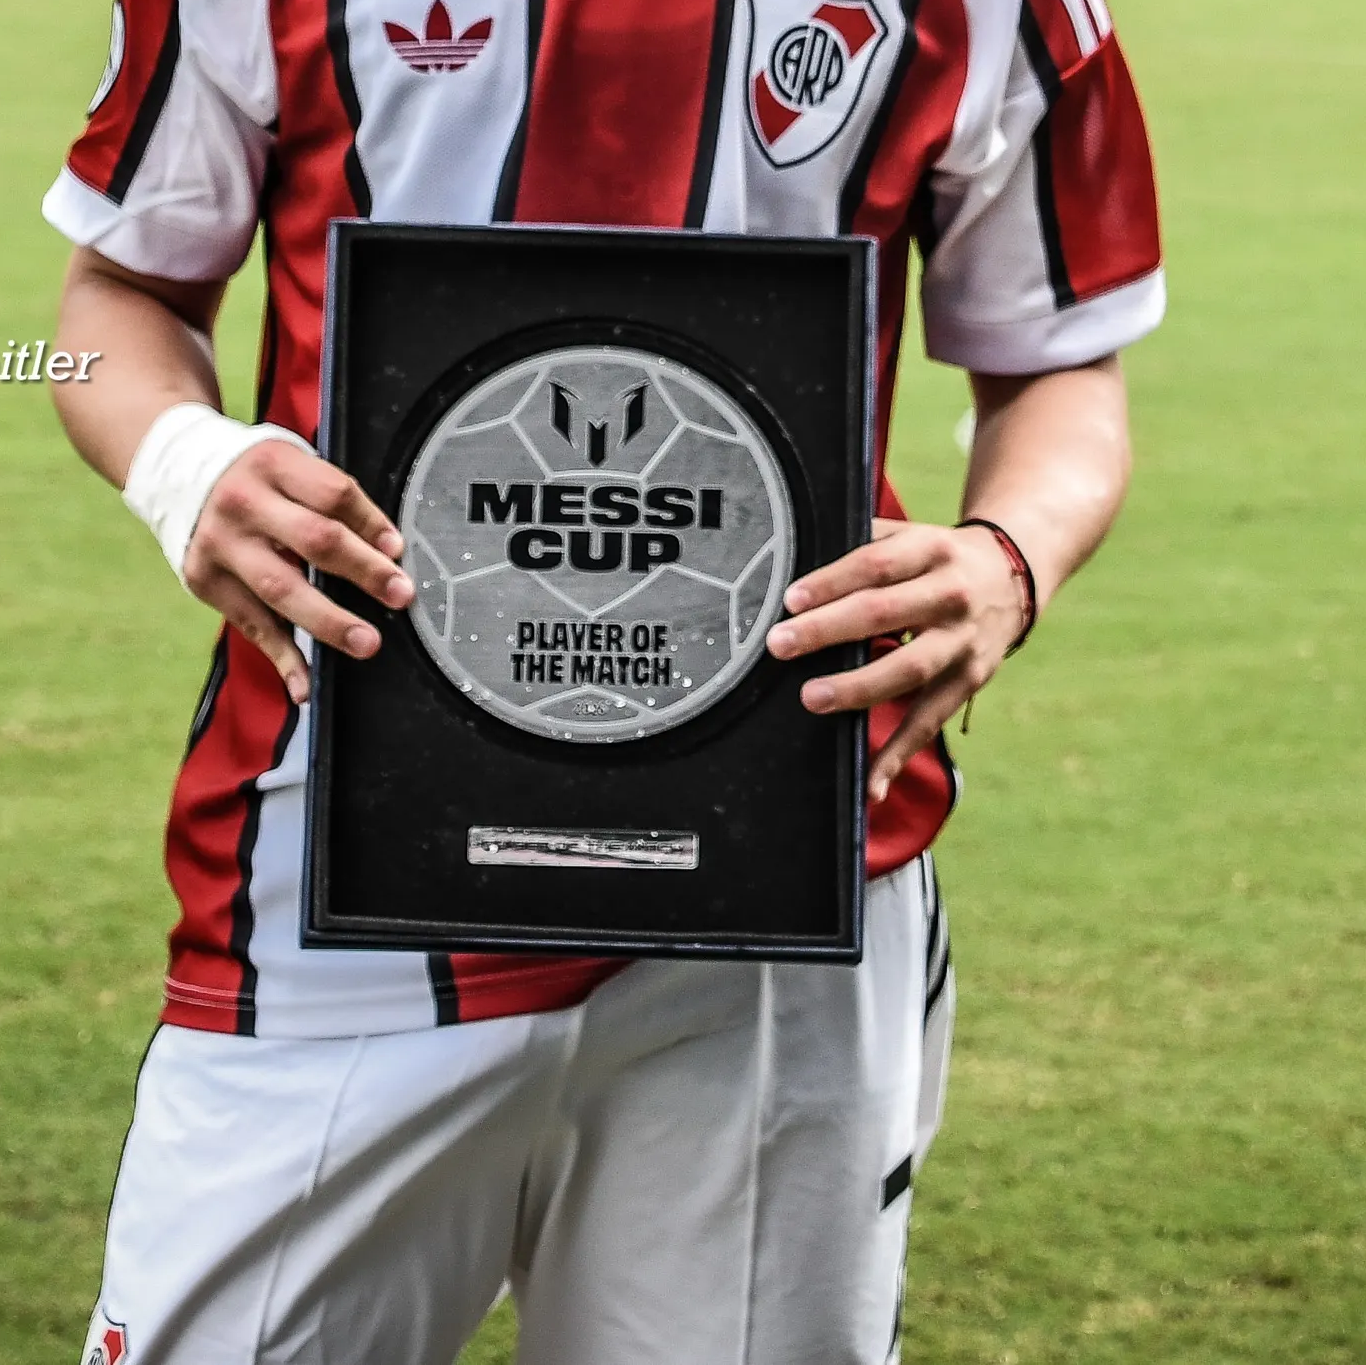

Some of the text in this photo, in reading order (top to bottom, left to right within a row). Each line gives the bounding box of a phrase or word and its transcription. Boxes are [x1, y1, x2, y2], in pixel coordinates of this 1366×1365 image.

[467, 482, 723, 529] MESSI
[509, 528, 680, 572] CUP
[516, 621, 669, 653] PLAYER OF
[510, 653, 672, 686] THE MATCH
